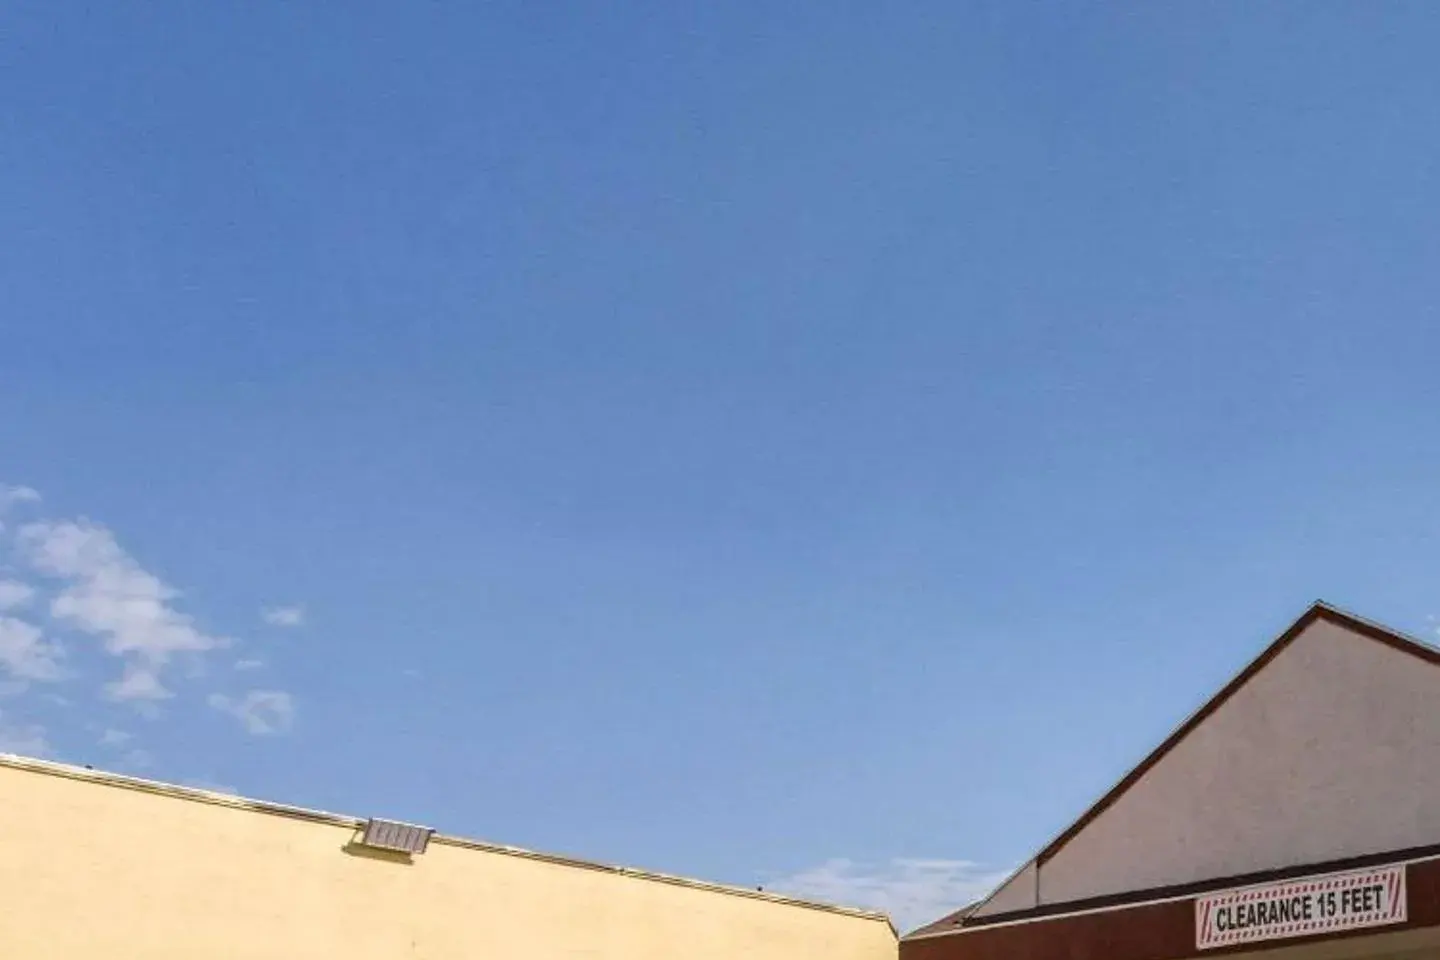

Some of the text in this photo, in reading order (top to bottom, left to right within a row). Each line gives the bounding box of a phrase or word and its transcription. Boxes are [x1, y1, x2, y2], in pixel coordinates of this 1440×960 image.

[1216, 884, 1384, 932] CLEARANCE 15 FEET
